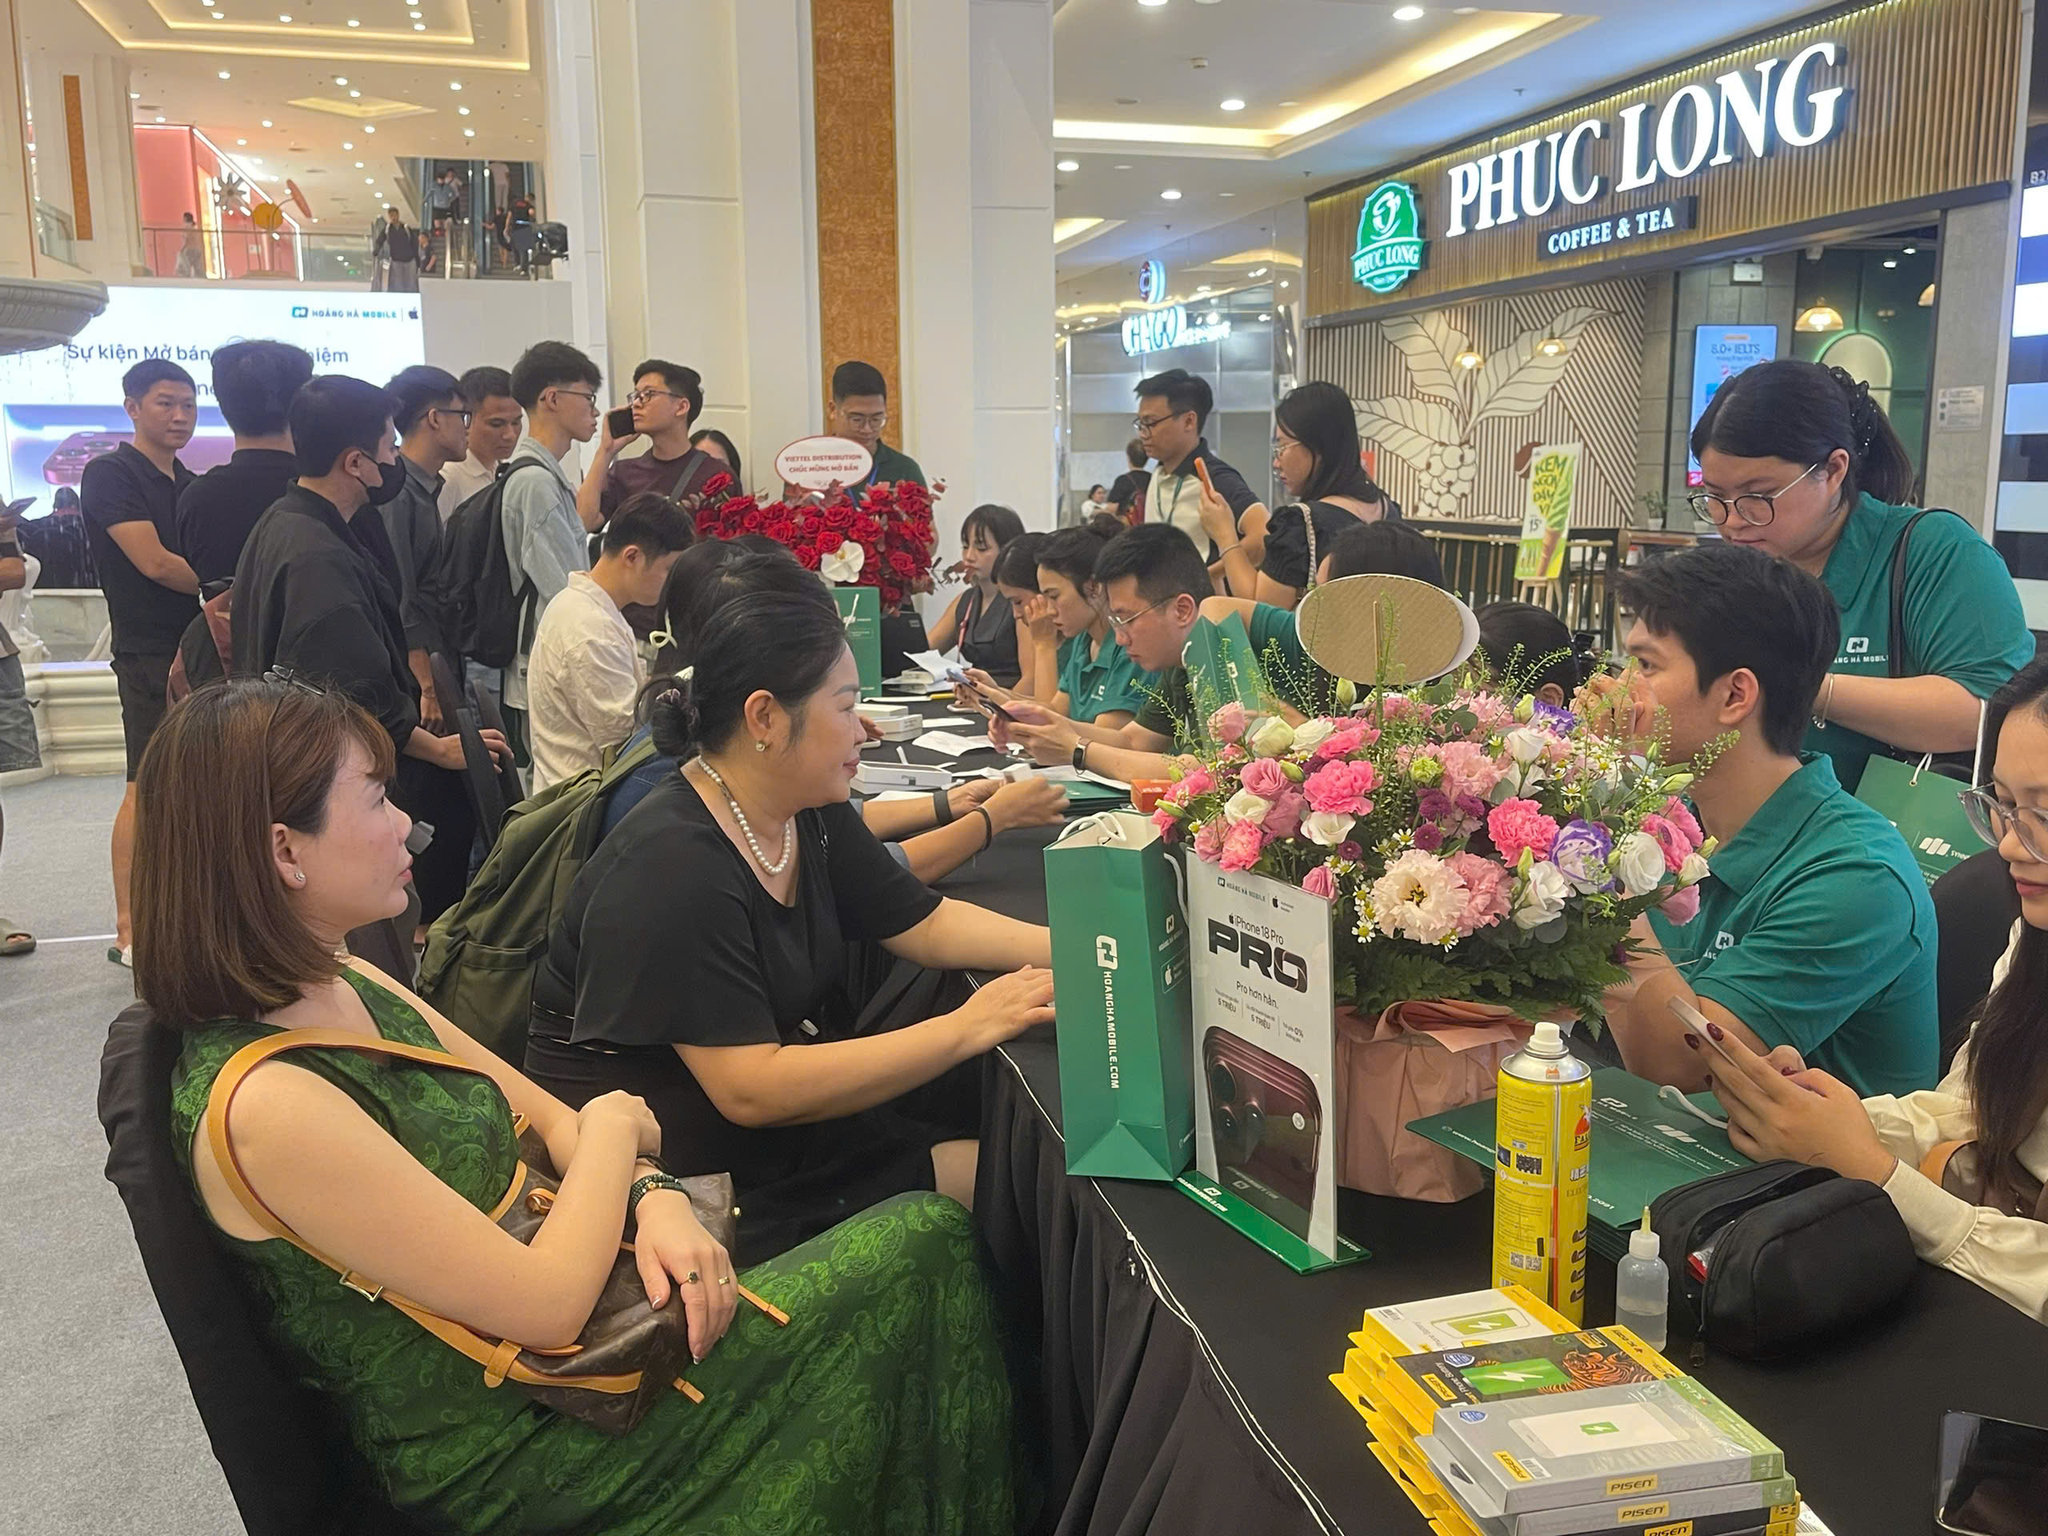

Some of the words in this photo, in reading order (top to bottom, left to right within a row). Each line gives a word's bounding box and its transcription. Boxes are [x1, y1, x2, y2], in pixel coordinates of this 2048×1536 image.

[1445, 119, 1601, 238] PHUC
[1615, 41, 1844, 192] LONG
[1547, 223, 1612, 254] COFFEE
[1616, 217, 1631, 239] &
[1635, 206, 1675, 233] TEA
[1354, 249, 1385, 278] PHUC
[1385, 244, 1420, 265] LONG
[362, 310, 397, 318] MOBILE
[68, 344, 93, 362] Sự
[98, 344, 139, 364] kiện
[812, 454, 862, 462] DISTRIBUTION
[1535, 454, 1568, 477] KEM
[1234, 914, 1261, 935] iPhone
[1260, 925, 1270, 940] 18
[1270, 929, 1284, 945] Pro
[1207, 918, 1308, 994] PRO
[1236, 980, 1248, 995] Pro
[1103, 970, 1120, 1090] HOANGHAMOBILE.COM
[1610, 1479, 1652, 1492] PISEN
[1621, 1506, 1665, 1519] PISEN
[1649, 1526, 1689, 1536] PISEN
